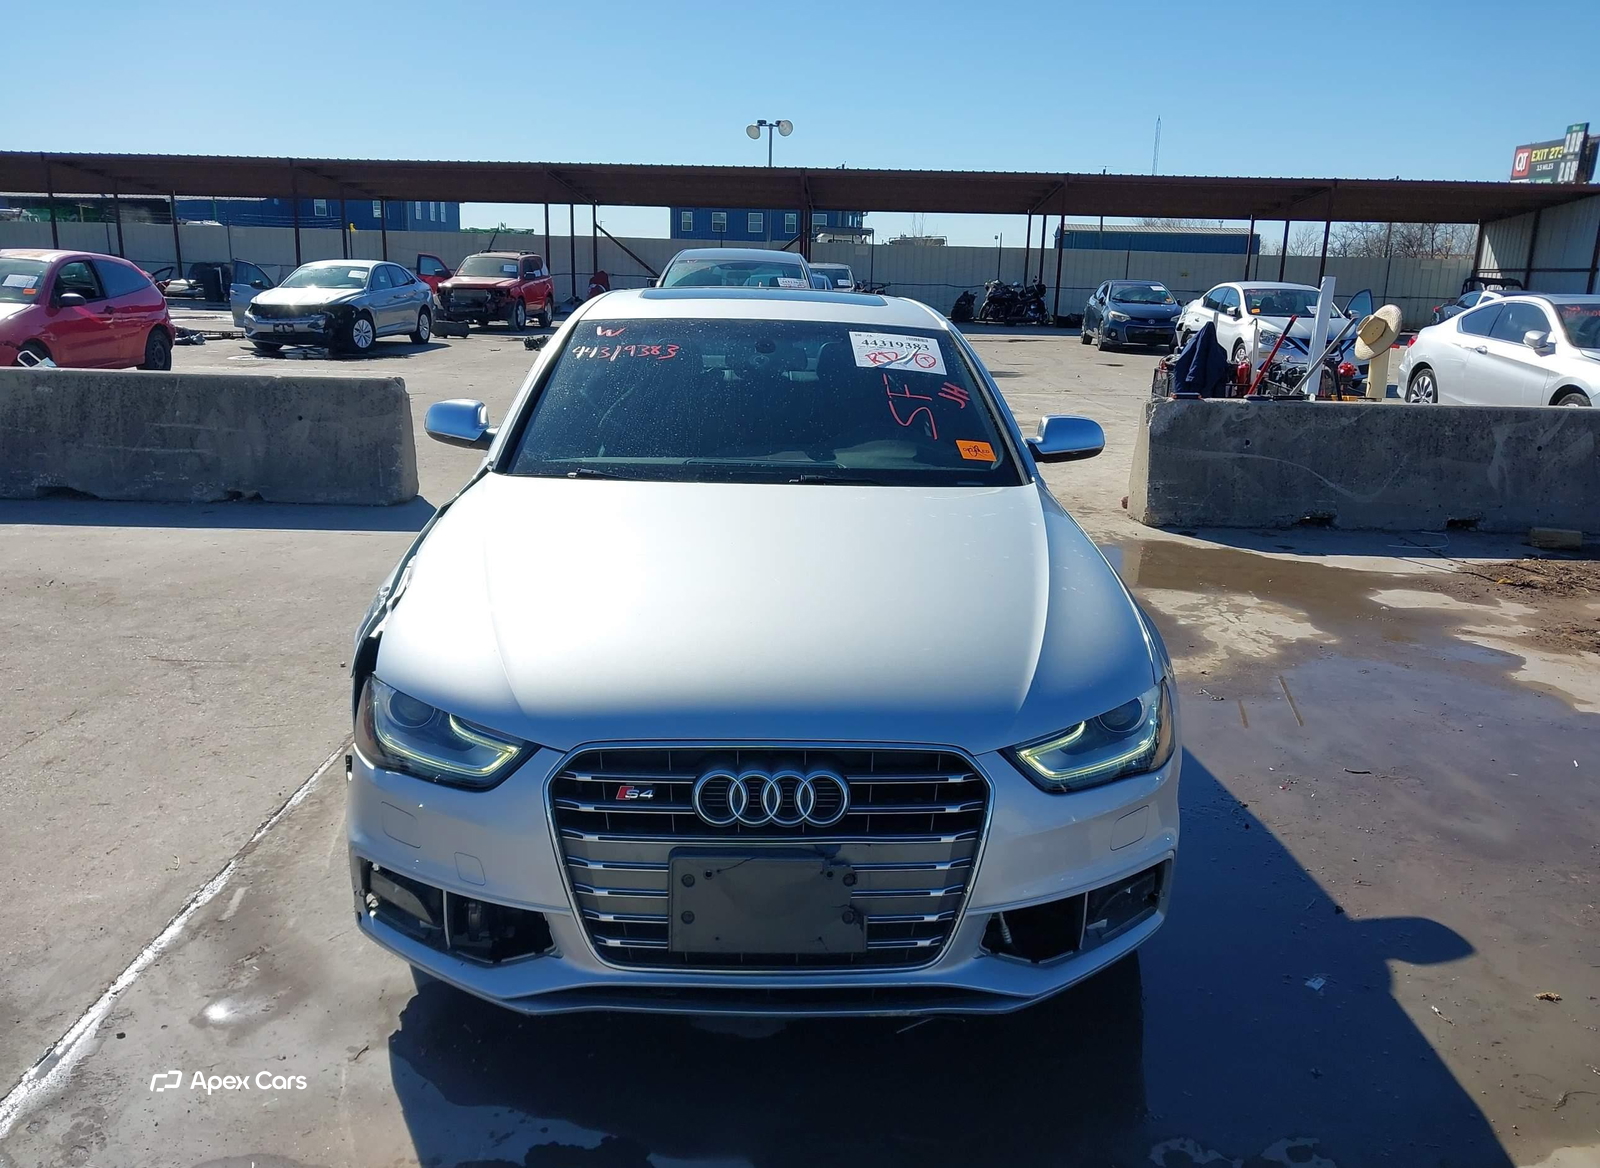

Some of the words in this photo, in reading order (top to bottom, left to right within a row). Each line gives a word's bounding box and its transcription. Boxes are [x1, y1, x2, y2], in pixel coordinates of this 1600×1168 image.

[1531, 148, 1549, 162] EXIT
[1515, 152, 1529, 172] QT
[596, 326, 626, 337] W
[861, 338, 930, 351] 44319383
[624, 788, 654, 799] S4
